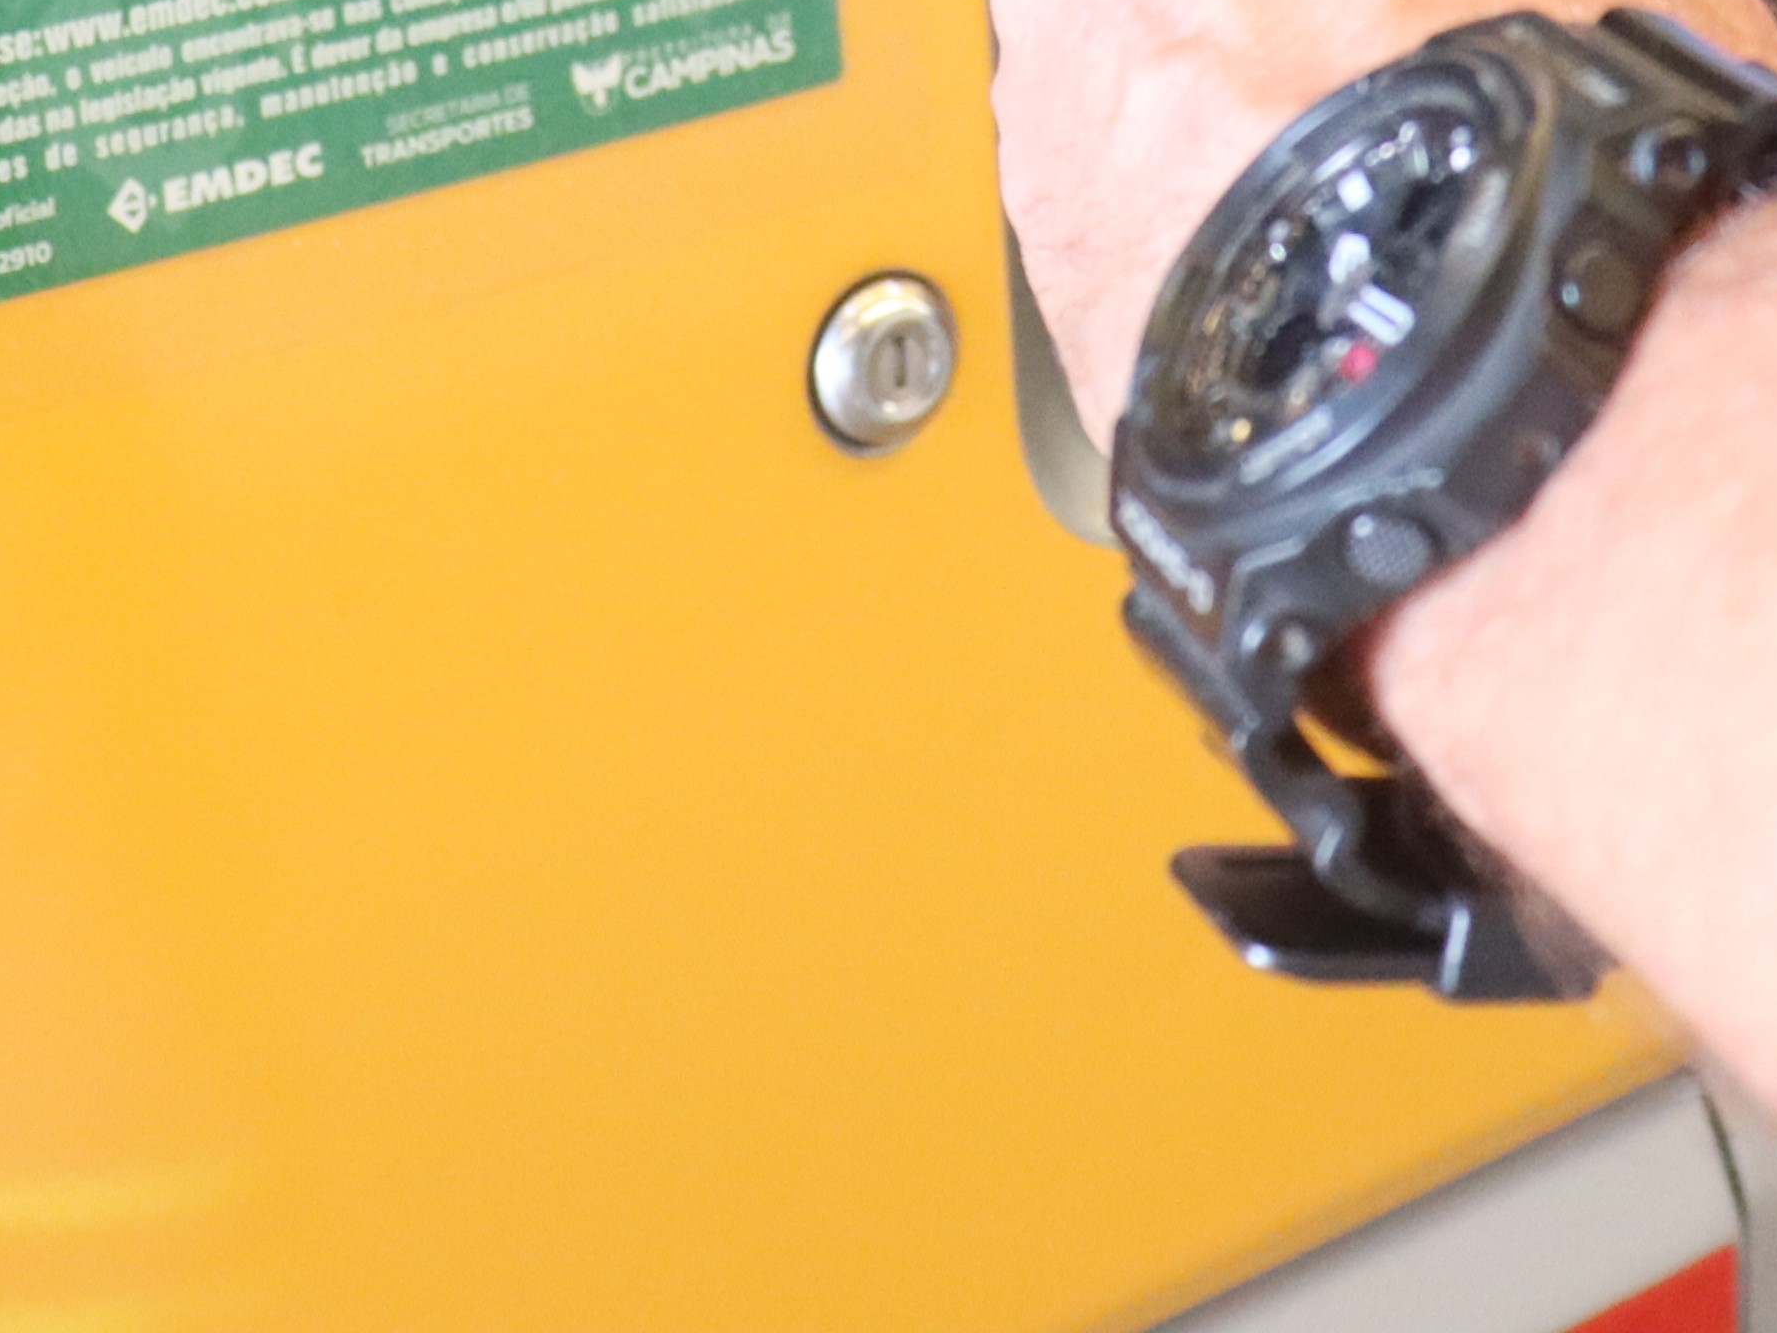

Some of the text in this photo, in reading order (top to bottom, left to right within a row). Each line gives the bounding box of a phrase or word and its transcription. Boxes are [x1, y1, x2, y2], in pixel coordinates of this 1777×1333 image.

[44, 142, 78, 171] de
[95, 106, 244, 158] segurança,
[260, 58, 418, 119] manutenção
[432, 52, 449, 76] e
[462, 8, 619, 69] conservação
[45, 106, 75, 134] na
[80, 76, 196, 125] legislação
[311, 36, 371, 69] dever
[65, 66, 83, 91] o
[623, 28, 796, 100] CAMPINAS
[360, 106, 535, 169] TRANSPORTES
[163, 142, 324, 214] EMDEC
